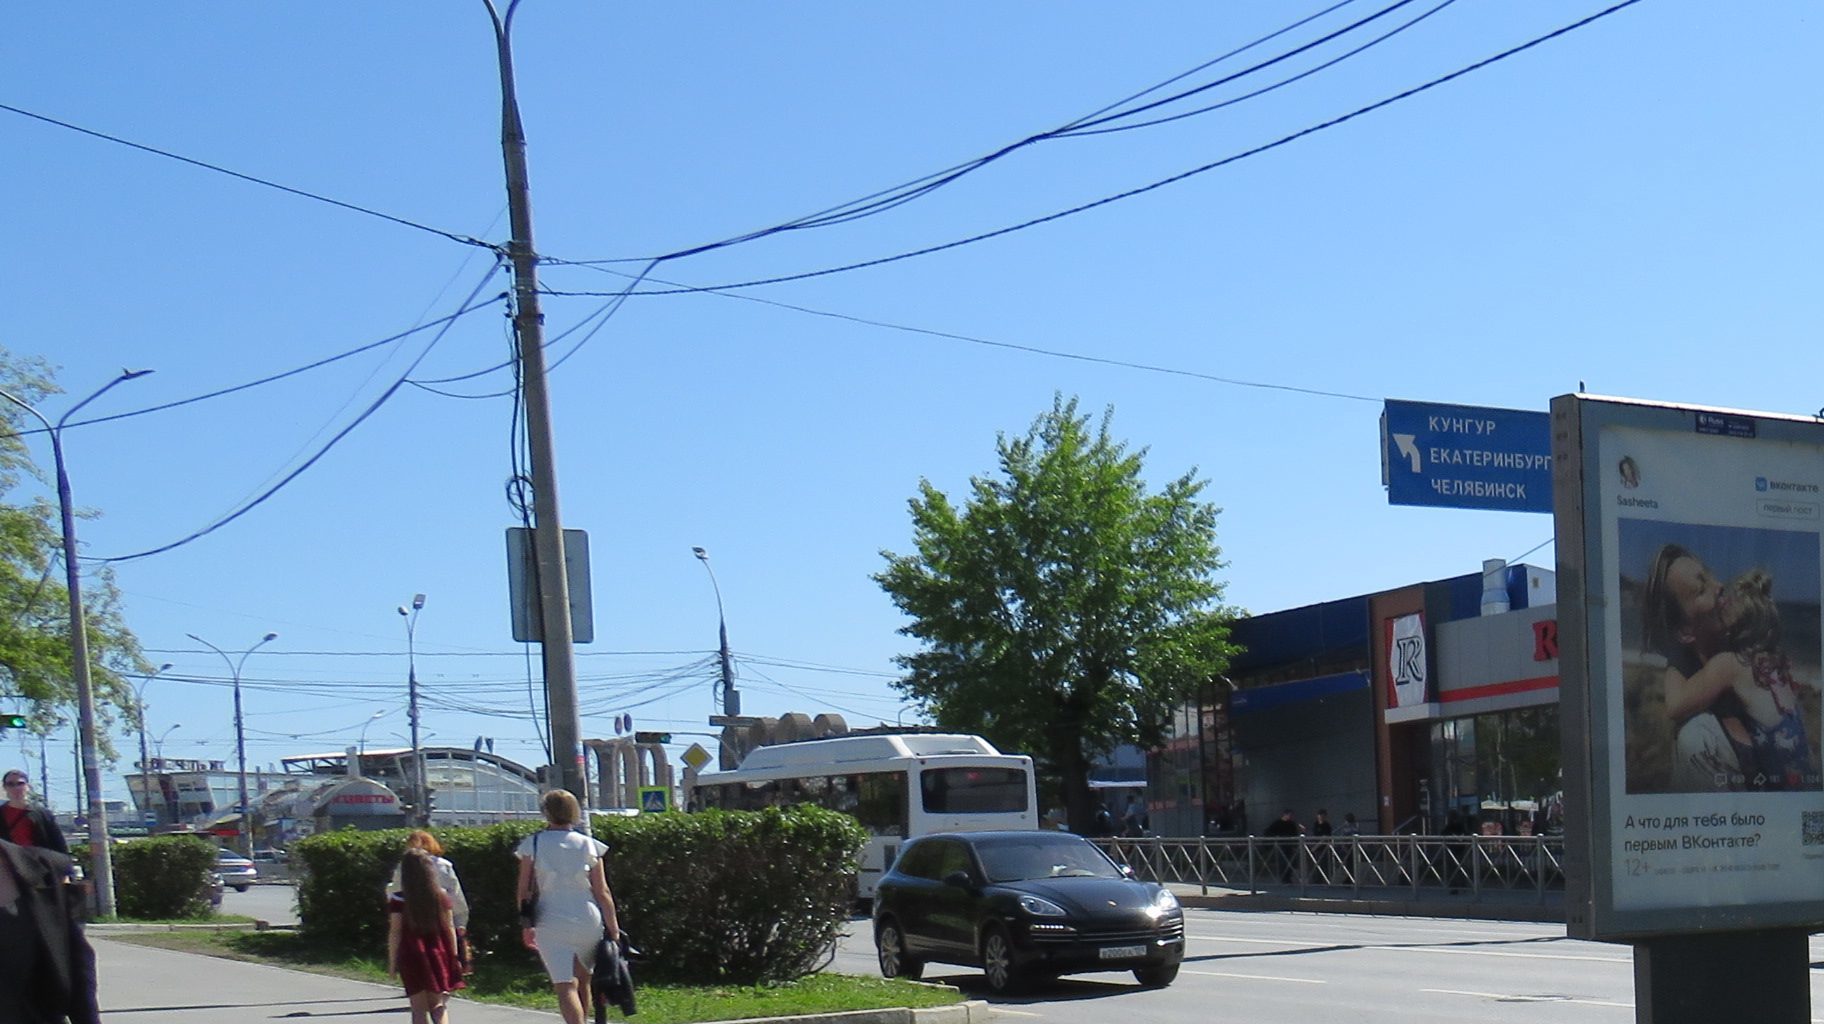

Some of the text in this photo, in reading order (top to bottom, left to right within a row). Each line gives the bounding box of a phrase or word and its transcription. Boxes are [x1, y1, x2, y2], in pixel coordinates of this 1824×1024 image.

[1428, 415, 1496, 436] КУНГУР
[1430, 447, 1552, 471] ЕКАТЕРИНБУРГ
[1431, 478, 1527, 500] ЧЕЛЯБИНСК
[1624, 811, 1766, 831] А что для тебя было
[1624, 833, 1761, 855] первым ВКонтакте?
[1625, 858, 1649, 876] 12+
